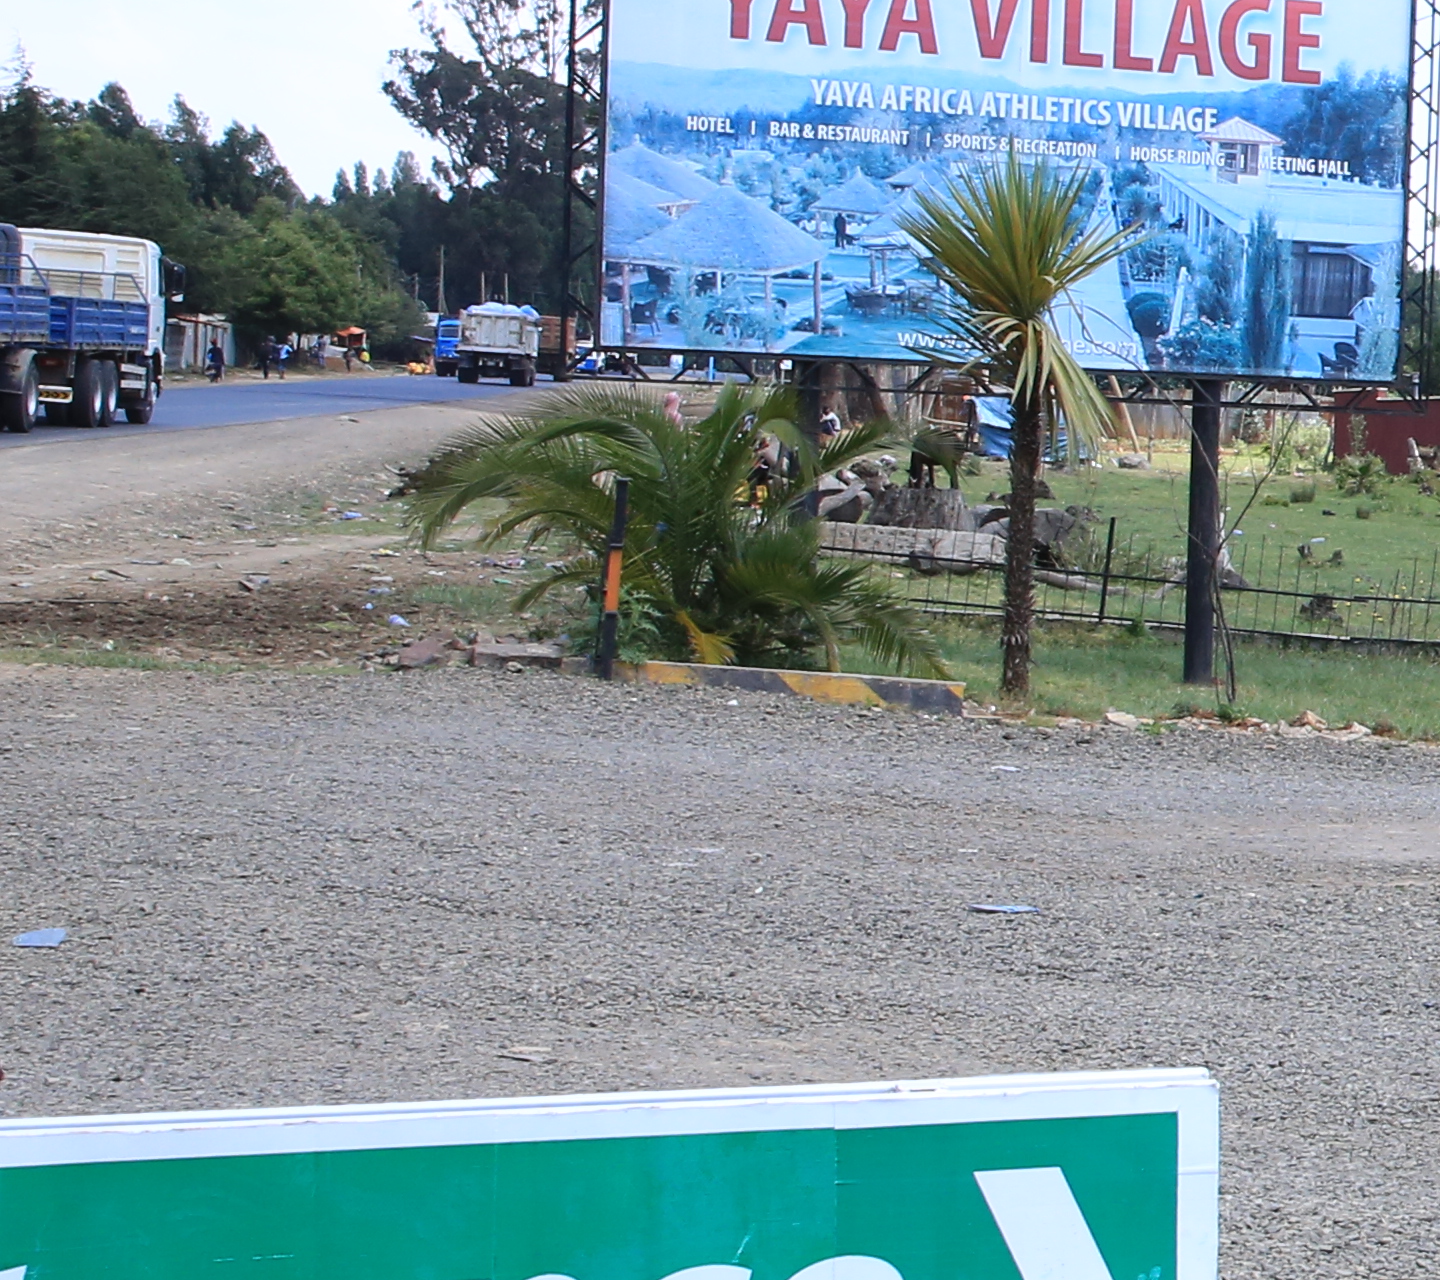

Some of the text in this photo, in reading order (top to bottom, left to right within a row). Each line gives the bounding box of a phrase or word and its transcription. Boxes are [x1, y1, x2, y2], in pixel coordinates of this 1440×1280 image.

[810, 78, 1218, 134] YAYA AFRICA ATHLETICS VILLAGE
[686, 115, 734, 134] HOTEL
[769, 121, 799, 138] BAR
[803, 123, 815, 139] &
[817, 124, 909, 146] RESTAURANT
[943, 133, 996, 150] SPORTS
[1000, 136, 1010, 152] &
[1014, 137, 1097, 158] RECREATION
[1130, 146, 1175, 163] HORSE
[1178, 149, 1226, 167] RIDING
[1257, 155, 1315, 174] MEETING
[1318, 159, 1352, 176] HALL
